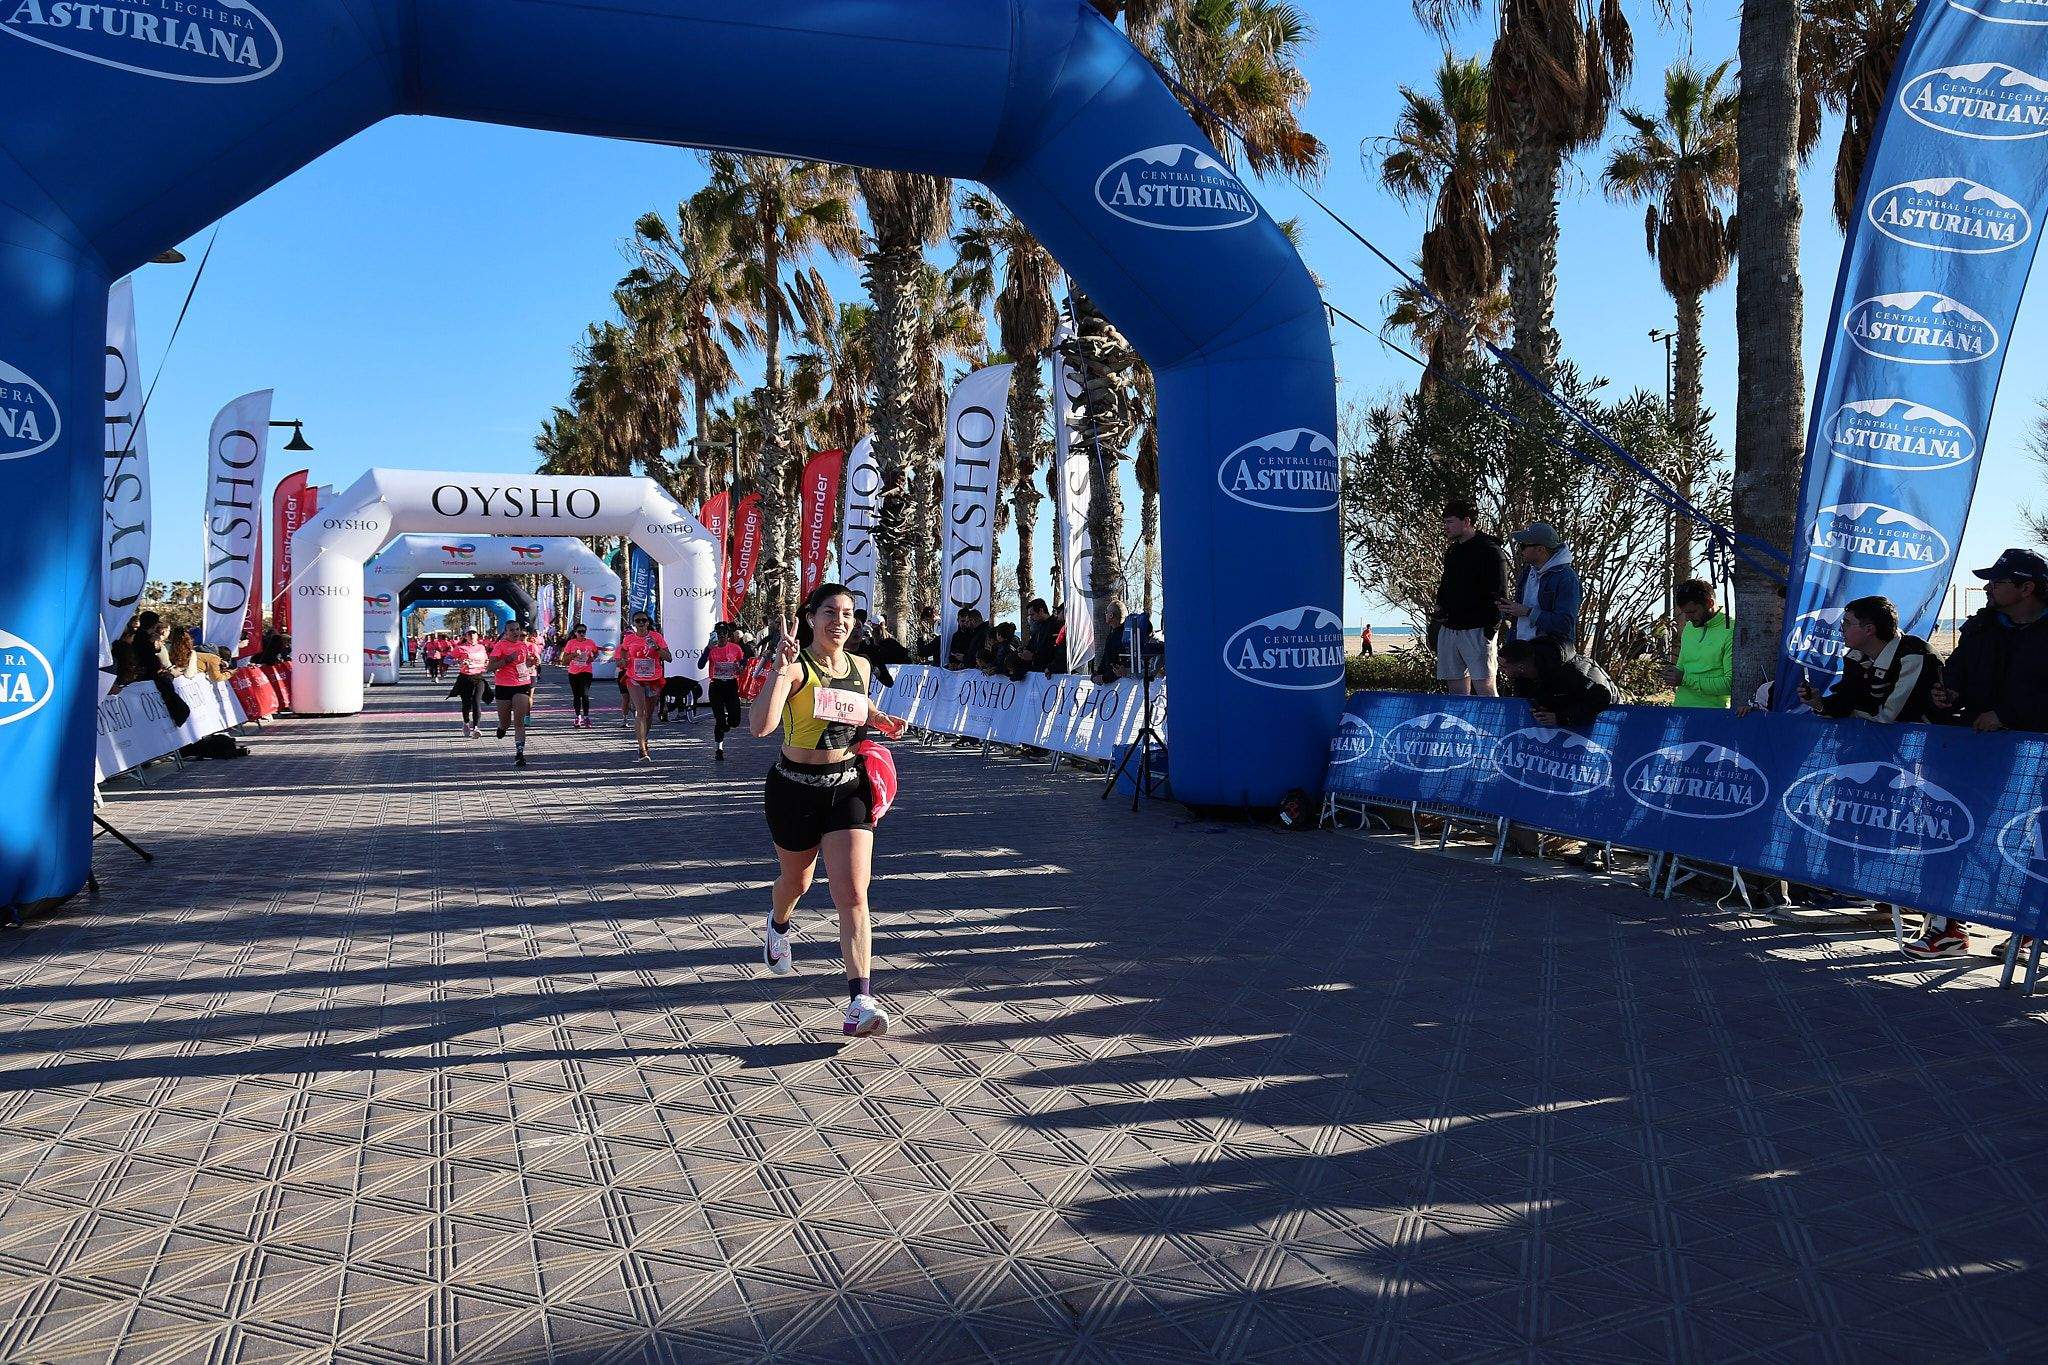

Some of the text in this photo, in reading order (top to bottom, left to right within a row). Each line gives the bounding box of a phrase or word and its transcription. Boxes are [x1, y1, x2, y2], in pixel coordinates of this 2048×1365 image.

[5, 0, 262, 69] ASTURIANA
[1942, 83, 2048, 103] CENTRAL LECHER
[1141, 170, 1196, 182] CENTRAL
[1109, 172, 1253, 214] ASTURIANA
[1908, 197, 2017, 220] CENTRAL LECHERA
[1877, 196, 2015, 243] ASTURIANA
[1853, 310, 1983, 355] ASTURIANA
[1875, 311, 1983, 333] CENTRAL LECHERA
[1849, 416, 1961, 438] CENTRAL LECHERA
[1231, 459, 1338, 493] ASTURIAN
[1259, 457, 1310, 465] CENTRAL
[431, 484, 601, 519] OYSHO
[808, 473, 828, 560] Santander
[950, 406, 996, 609] OYSHO
[207, 430, 258, 614] OYSHO
[323, 519, 379, 531] OYSHO
[646, 524, 694, 534] OYSHO
[1879, 528, 1932, 543] LECHERA
[736, 510, 758, 577] Santander
[298, 585, 350, 597] OYSHO
[673, 587, 717, 598] OYSHO
[675, 649, 702, 659] OYS
[1236, 638, 1344, 670] ASTURIAN
[1264, 634, 1315, 644] CENTRAL
[298, 653, 350, 664] OYSHO
[899, 673, 939, 701] OYSHO
[959, 680, 1016, 711] OYSHO
[1041, 684, 1119, 722] OYSHO
[1499, 742, 1602, 784] ASTURIANA
[1630, 764, 1754, 806] ASTURIANA
[1795, 784, 1954, 842] ASTURIANA
